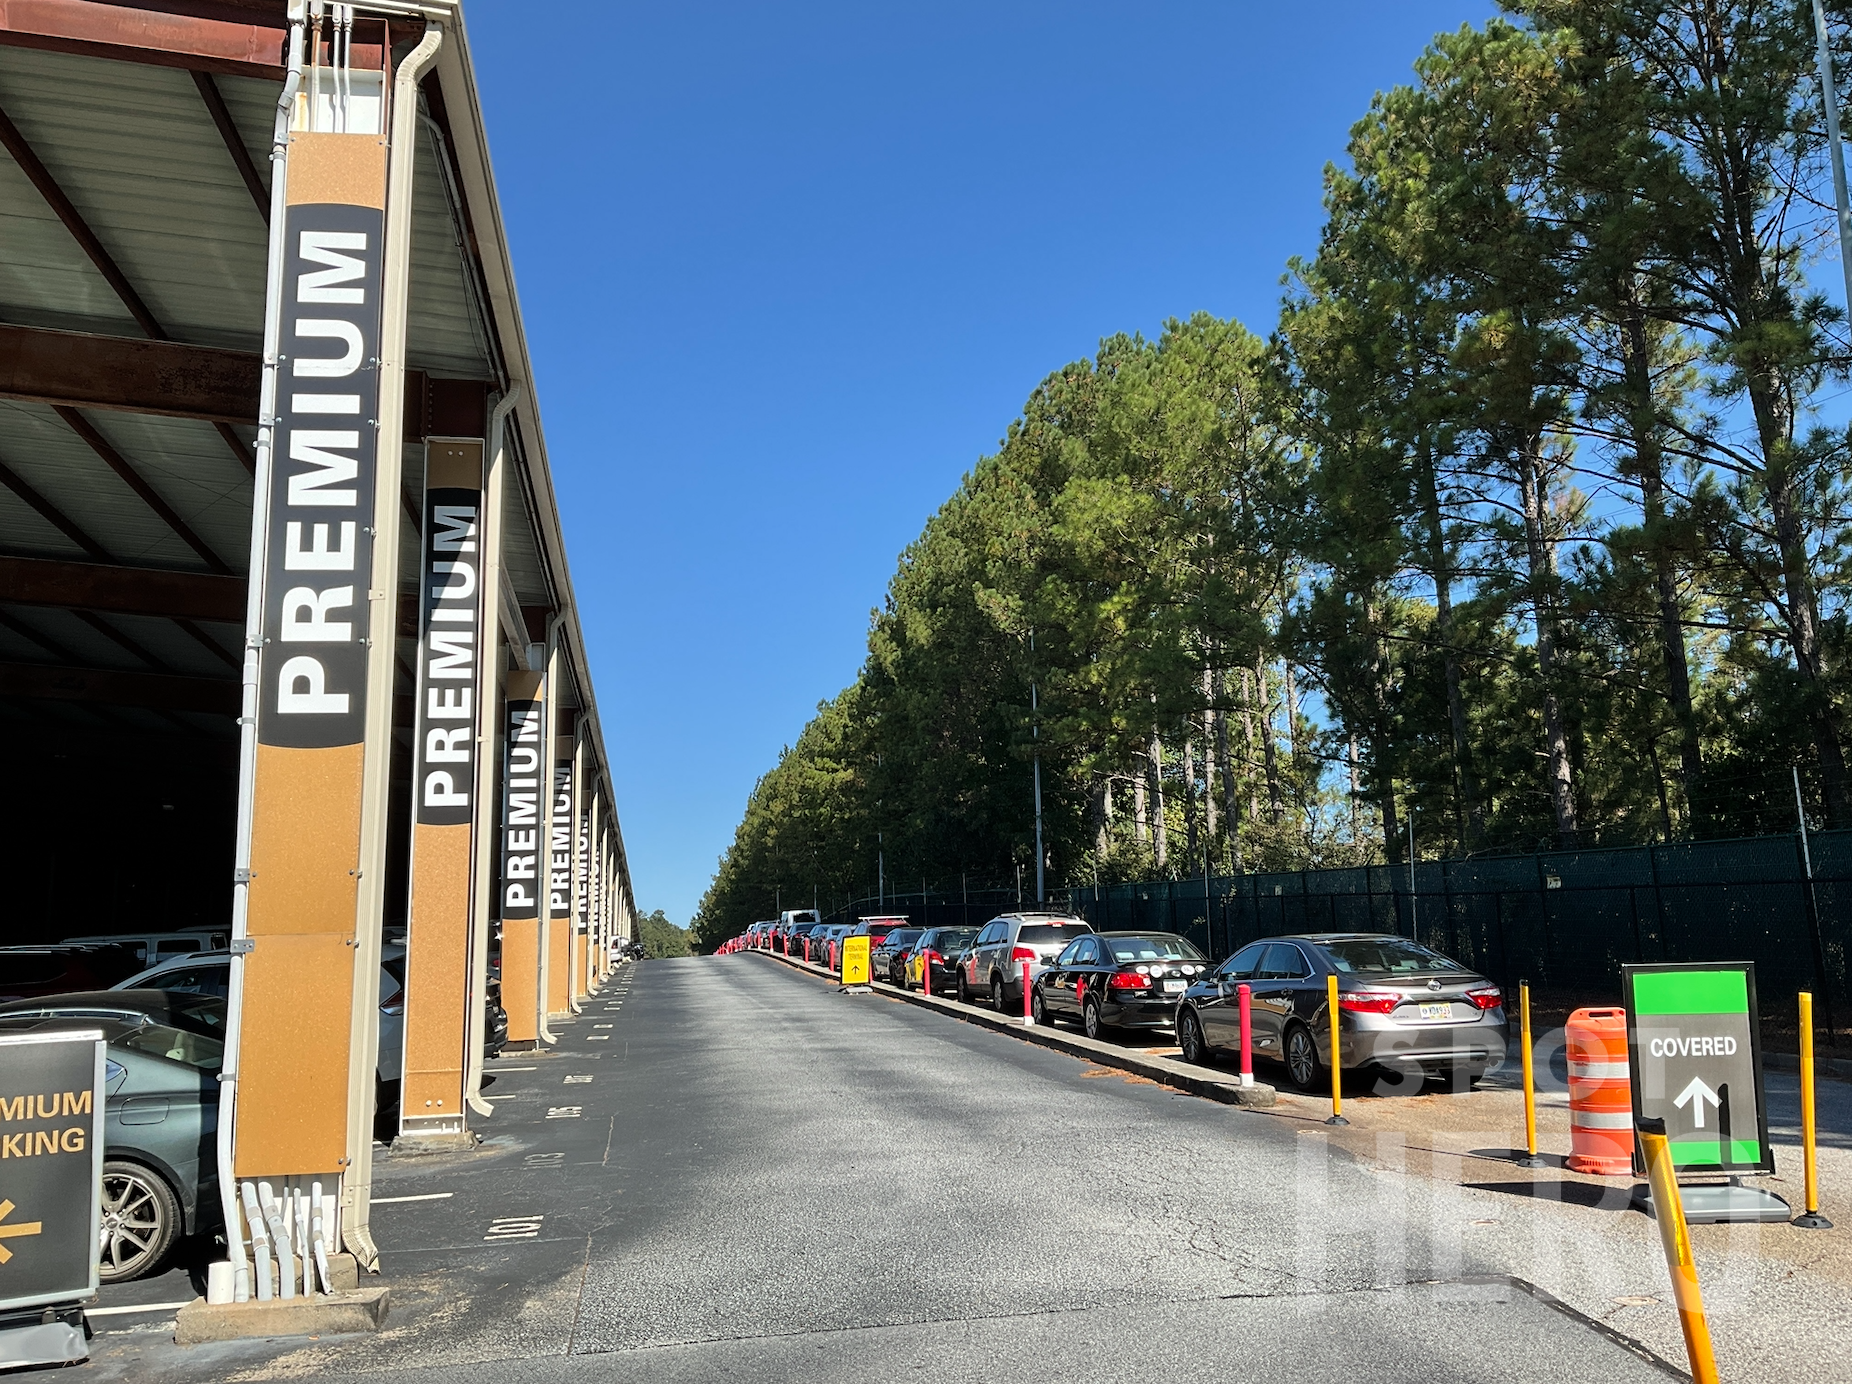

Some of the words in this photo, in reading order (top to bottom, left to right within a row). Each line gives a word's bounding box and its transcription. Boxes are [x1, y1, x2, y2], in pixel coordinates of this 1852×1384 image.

[277, 231, 367, 716] PREMIUM
[424, 506, 476, 808] PREMIUM
[506, 711, 539, 908] PREMIUM
[550, 767, 571, 910] PREMIUM
[0, 1090, 92, 1121] MIUM
[1650, 1037, 1737, 1057] COVERED
[2, 1127, 85, 1159] KING
